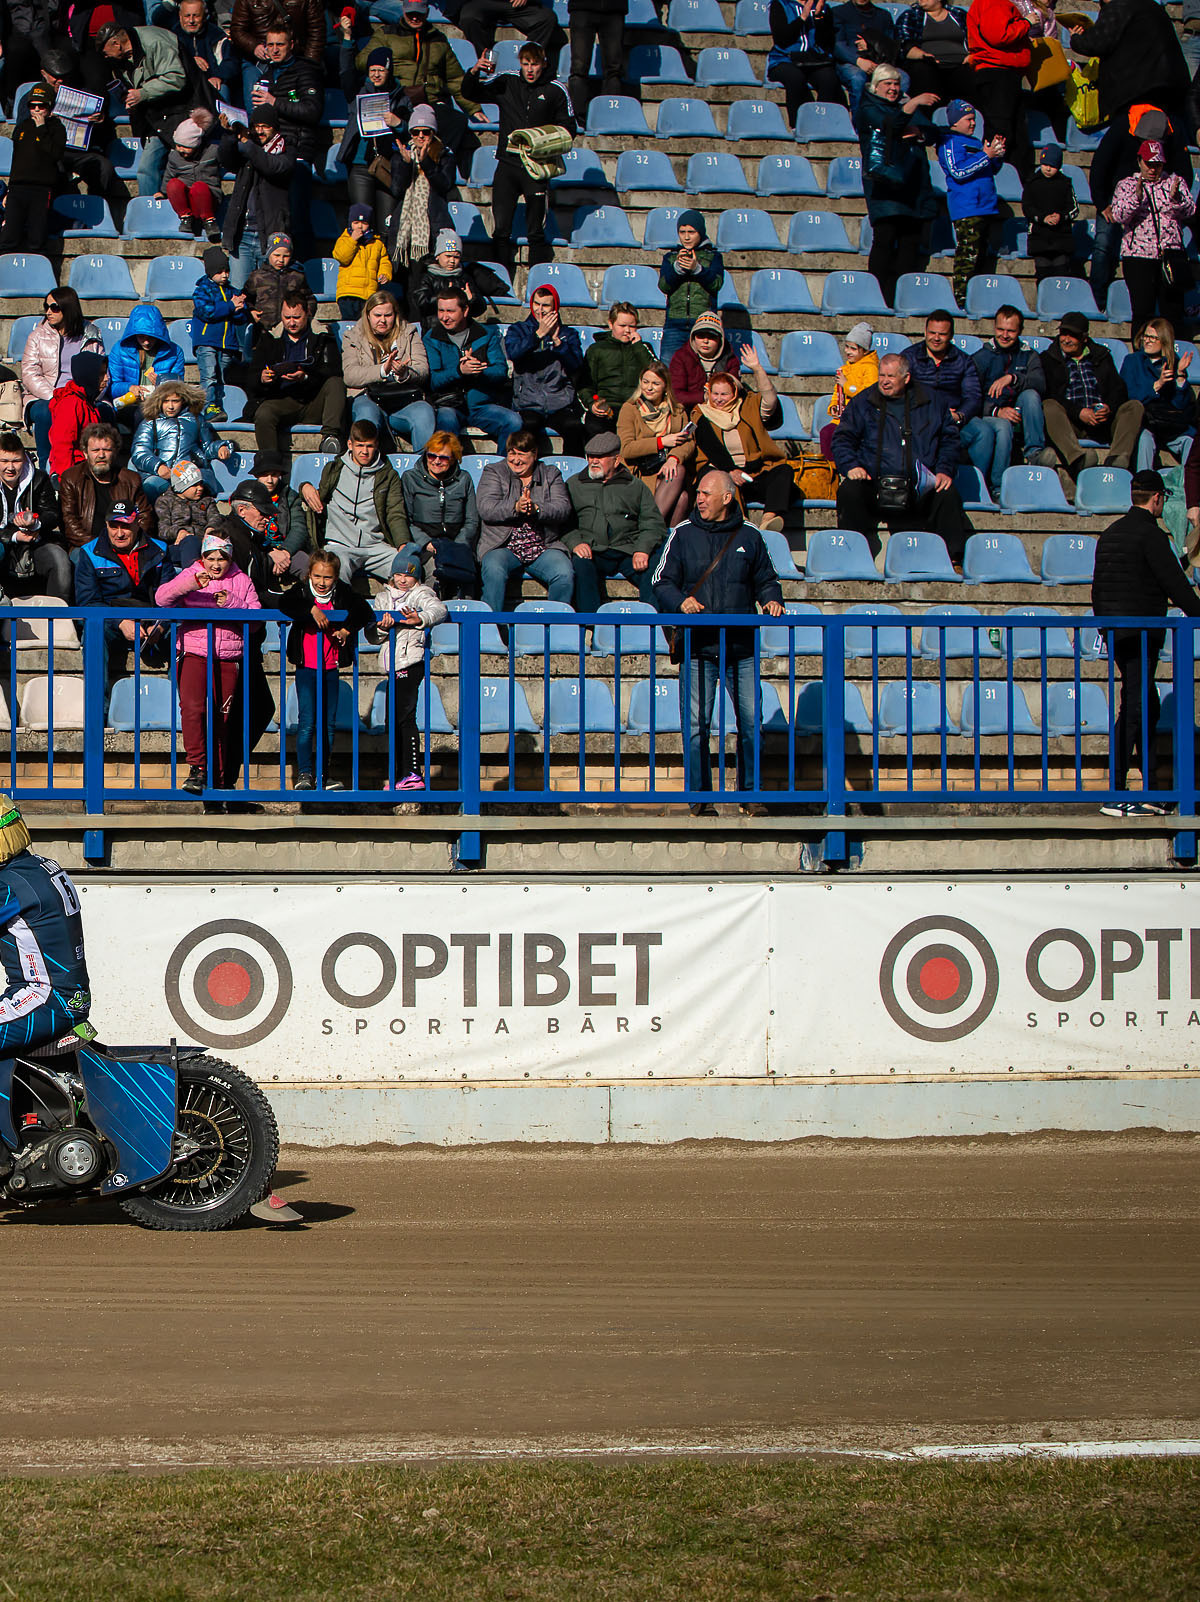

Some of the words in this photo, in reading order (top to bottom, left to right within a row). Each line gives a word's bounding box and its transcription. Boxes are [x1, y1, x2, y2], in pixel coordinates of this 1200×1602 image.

[718, 52, 729, 60] 30
[609, 100, 618, 108] 32
[681, 103, 688, 111] 31
[752, 105, 763, 113] 30
[126, 141, 138, 150] 39
[567, 151, 577, 159] 33
[637, 155, 648, 164] 32
[707, 157, 717, 165] 31
[777, 159, 790, 167] 30
[848, 160, 860, 168] 29
[147, 200, 161, 208] 39
[595, 210, 605, 218] 33
[737, 214, 747, 222] 31
[809, 215, 820, 224] 30
[13, 258, 25, 267] 41
[91, 259, 102, 267] 40
[171, 261, 183, 269] 39
[323, 262, 334, 271] 37
[548, 266, 559, 274] 34
[625, 269, 635, 277] 33
[771, 271, 780, 280] 31
[843, 275, 854, 283] 30
[916, 277, 928, 285] 29
[987, 279, 998, 287] 28
[1056, 280, 1070, 289] 27
[108, 321, 121, 330] 40
[653, 331, 663, 340] 33
[803, 336, 811, 344] 31
[876, 337, 888, 346] 30
[395, 457, 409, 467] 37
[1029, 472, 1041, 481] 29
[1103, 473, 1113, 482] 28
[832, 536, 844, 545] 32
[908, 537, 917, 547] 31
[1070, 540, 1083, 549] 29
[484, 687, 497, 697] 37
[656, 685, 667, 696] 35
[986, 689, 995, 699] 31
[322, 932, 662, 1008] OPTIBET
[322, 1019, 509, 1035] SPORTA
[548, 1012, 662, 1034] BĀRS
[207, 1075, 233, 1091] ANLAS
